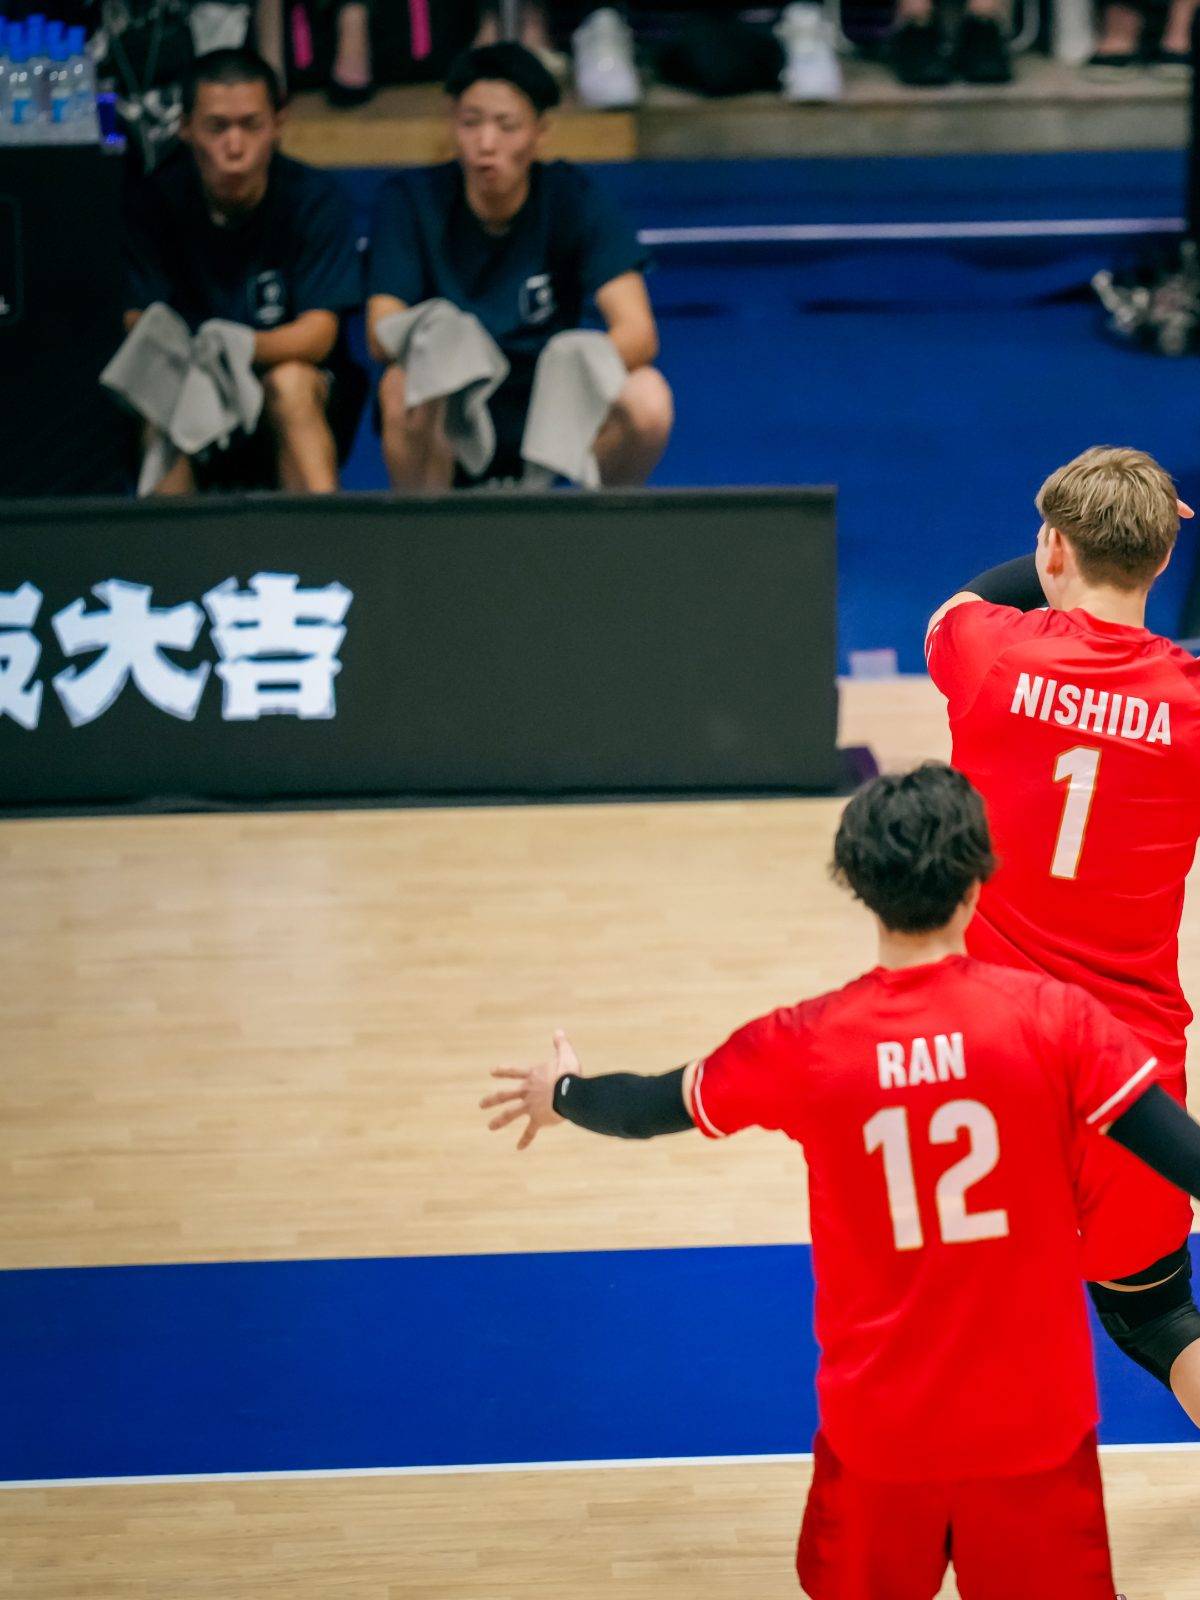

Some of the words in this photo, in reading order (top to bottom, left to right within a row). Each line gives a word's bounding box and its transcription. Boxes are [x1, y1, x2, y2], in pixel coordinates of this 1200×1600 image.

[1010, 672, 1172, 745] NISHIDA
[1051, 745, 1102, 880] 1
[876, 1031, 967, 1090] RAN
[862, 1098, 1009, 1252] 12
